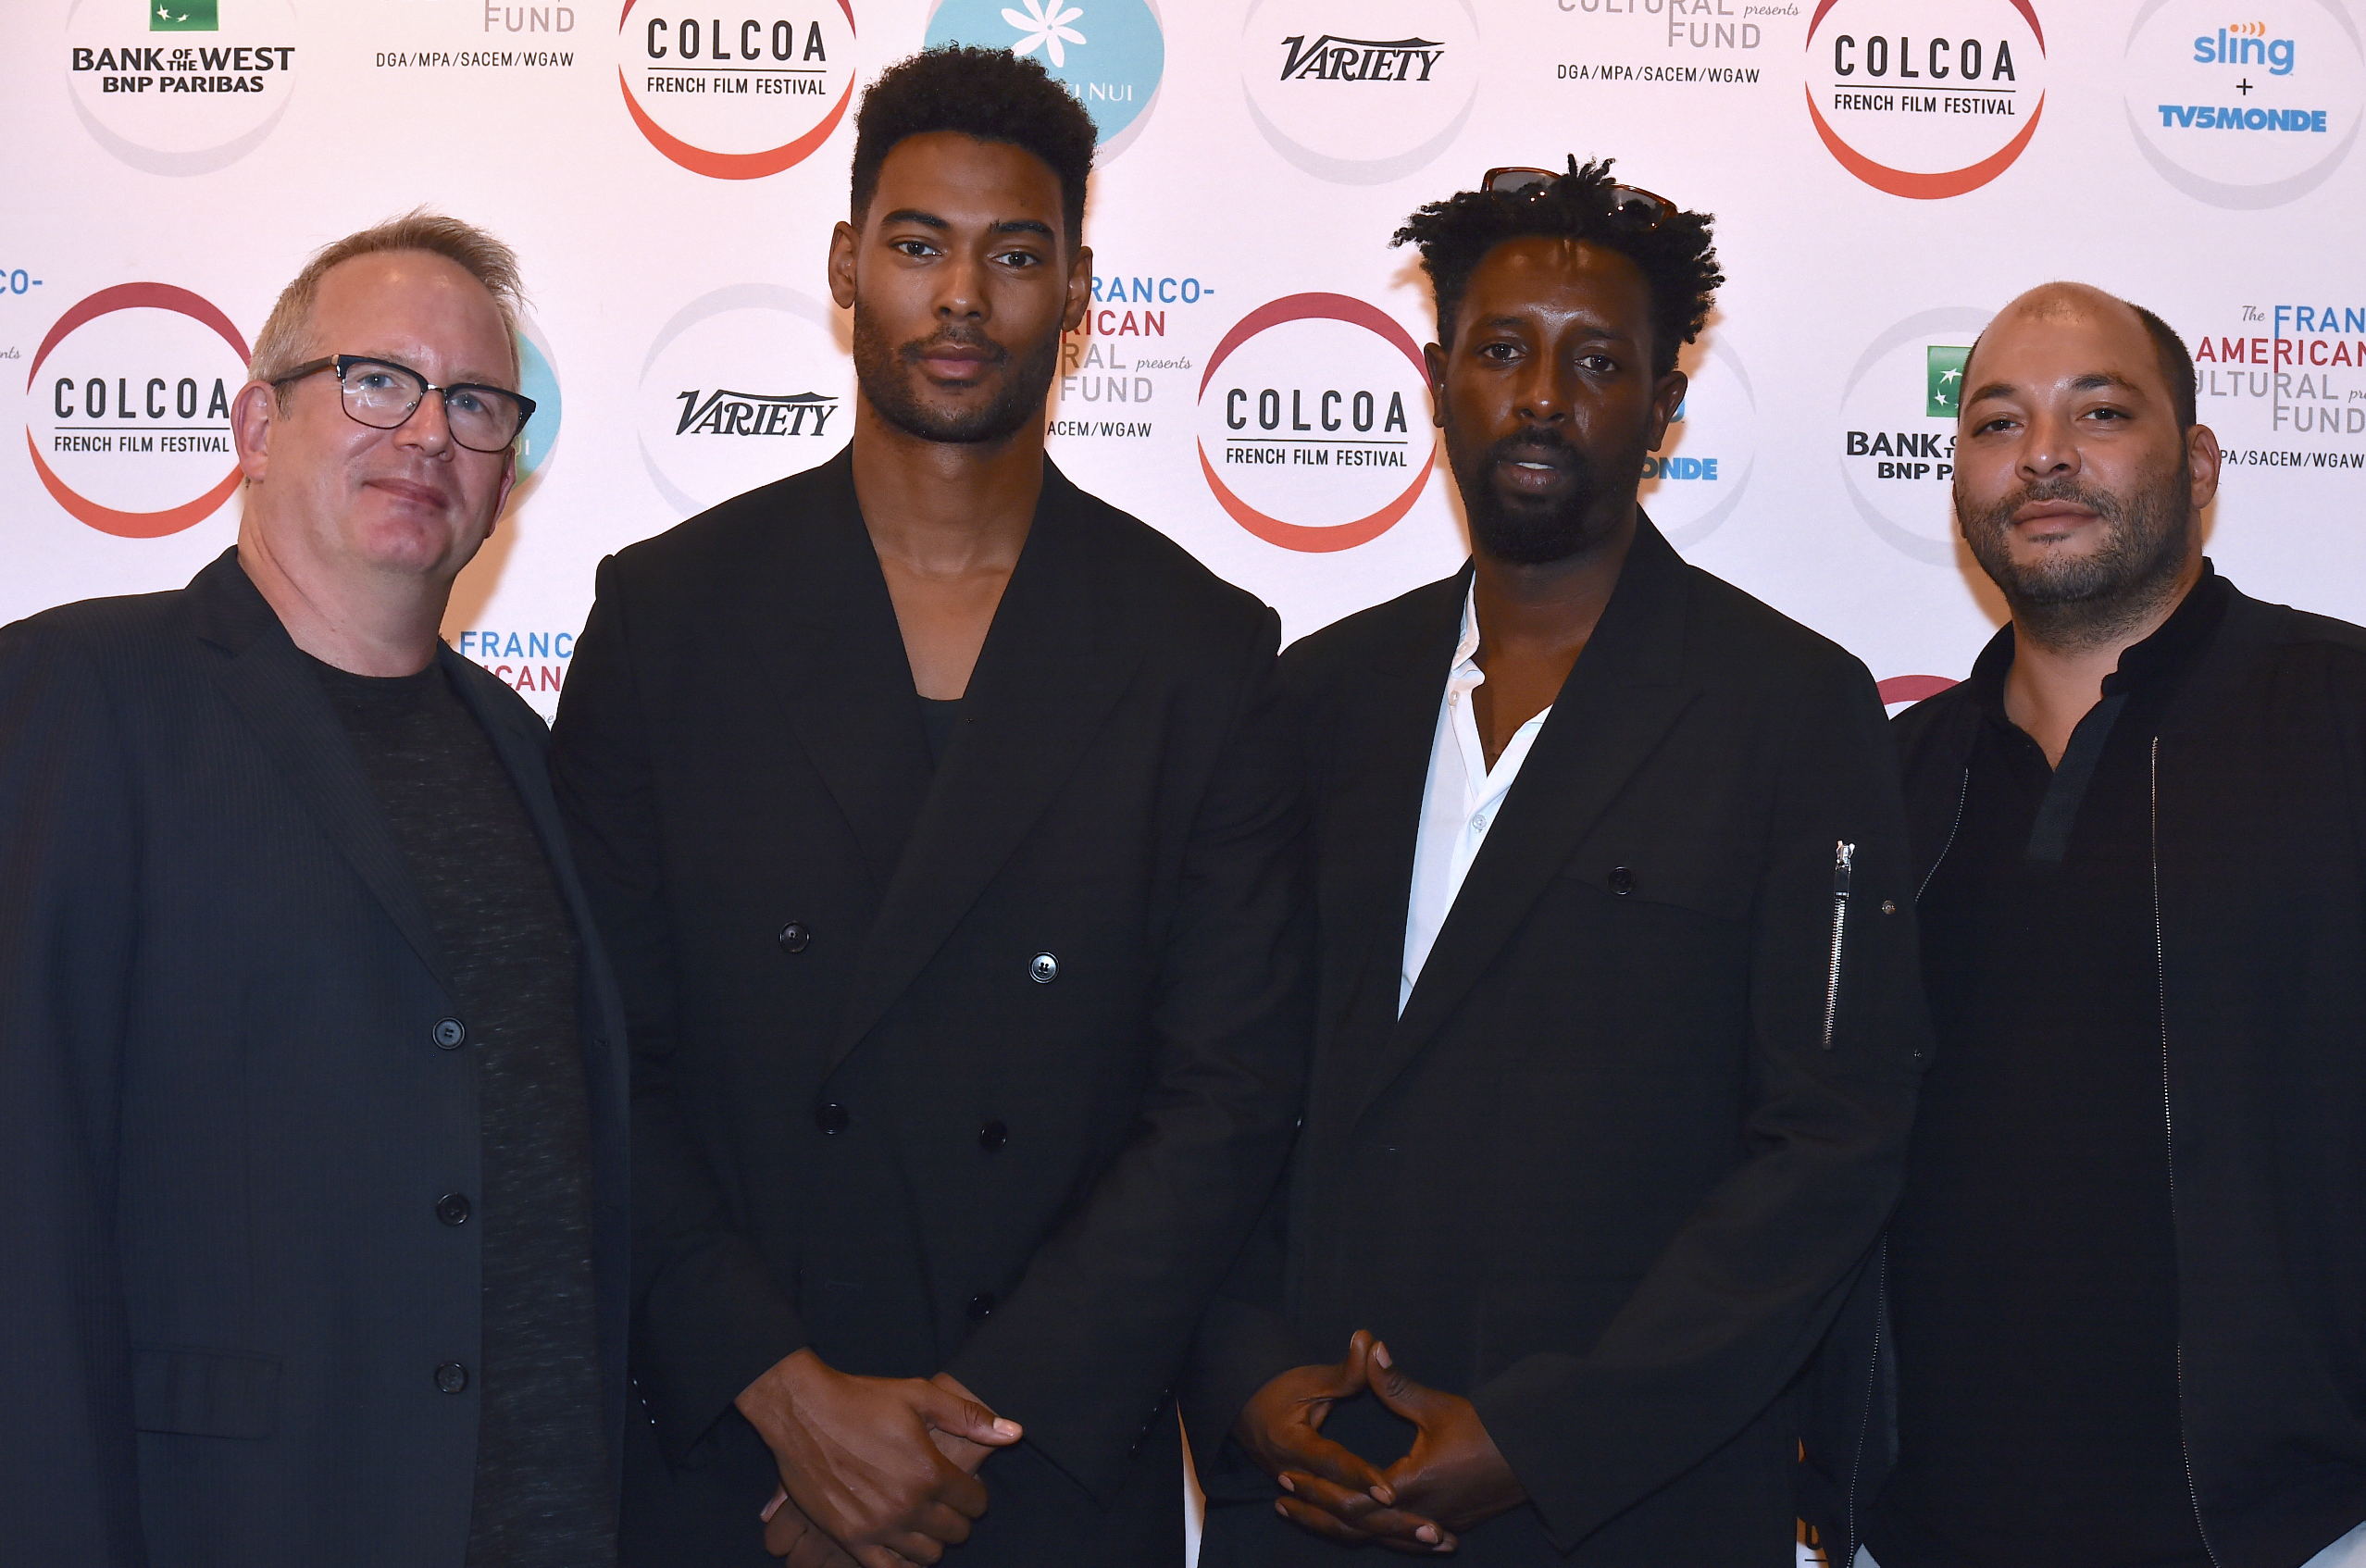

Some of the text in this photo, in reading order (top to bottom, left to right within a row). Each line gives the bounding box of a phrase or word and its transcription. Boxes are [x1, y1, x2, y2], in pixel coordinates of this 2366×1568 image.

[485, 6, 575, 32] FUND
[1744, 3, 1800, 19] presents
[648, 18, 826, 62] COLCOA
[1668, 22, 1761, 49] FUND
[2194, 21, 2294, 76] sling
[72, 47, 295, 71] BANK OF THE WEST
[377, 52, 574, 67] DGA/MPA/SACEM/WGAW
[1280, 34, 1445, 81] VARIETY
[1835, 35, 2016, 81] COLCOA
[103, 76, 264, 93] BNP PARIBAS
[648, 77, 826, 95] FRENCH FILM FESTIVAL
[1558, 64, 1760, 83] DGA/MPA/SACEM/WGAW
[1090, 82, 1132, 101] NUI
[1835, 93, 2015, 116] FRENCH FILM FESTIVAL
[2159, 105, 2327, 132] TV5MONDE
[2242, 305, 2366, 339] The FRAN
[1136, 356, 1192, 372] presents
[55, 378, 230, 418] COLCOA
[1061, 376, 1153, 403] FUND
[676, 389, 839, 436] VARIETY
[1227, 389, 1407, 432] COLCOA
[2273, 405, 2366, 433] FUND
[55, 436, 230, 453] FRENCH FILM FESTIVAL
[1227, 447, 1407, 467] FRENCH FILM FESTIVAL
[1847, 431, 1942, 458] BANK
[1878, 462, 1930, 479] BNP
[460, 631, 573, 658] FRANC
[483, 666, 561, 691] CAN
